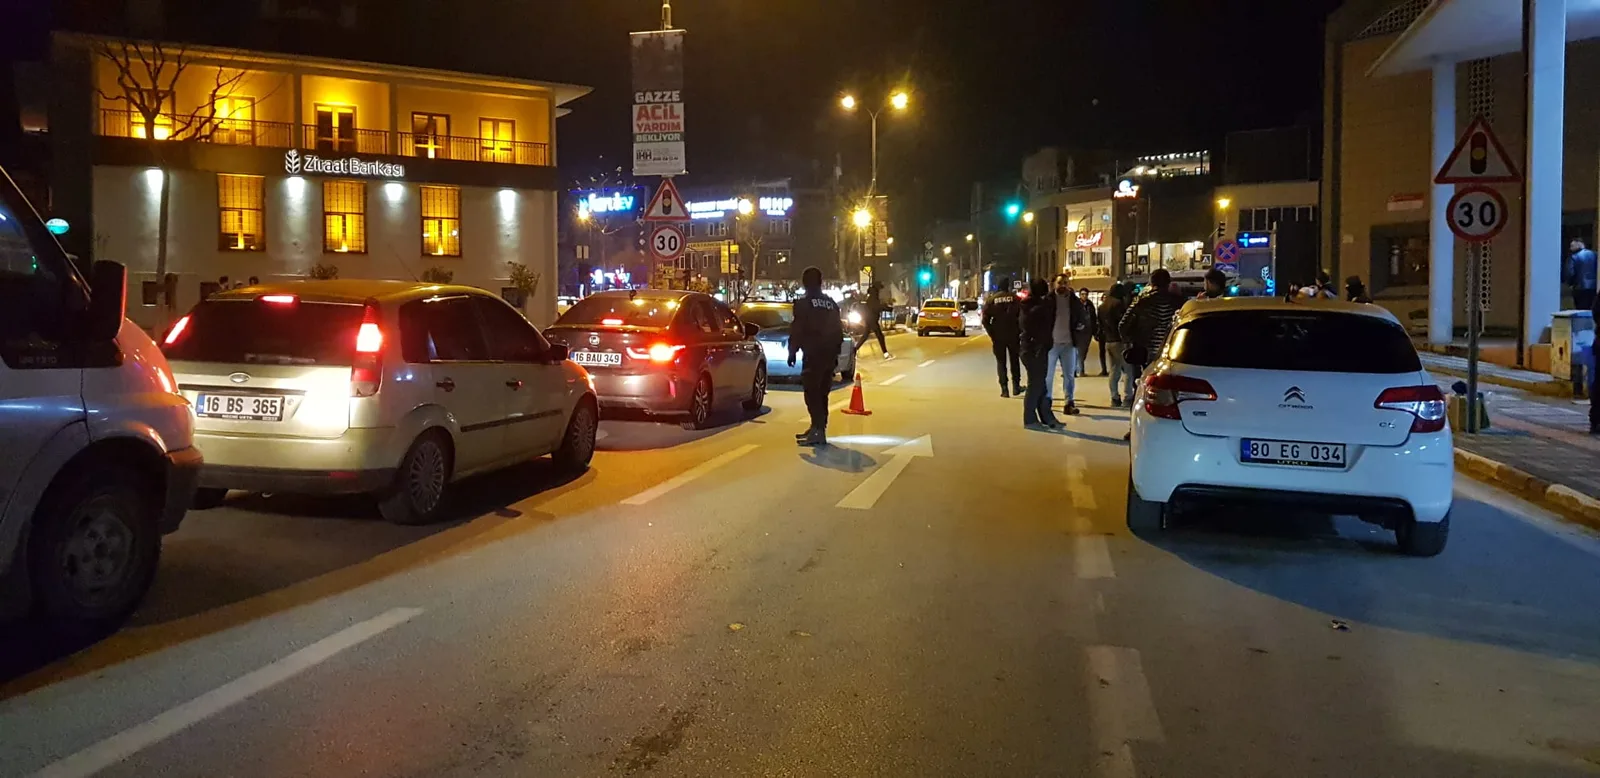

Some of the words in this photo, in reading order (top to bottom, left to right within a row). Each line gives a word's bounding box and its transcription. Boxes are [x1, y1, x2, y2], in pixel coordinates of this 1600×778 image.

[635, 90, 681, 103] GAZZE
[636, 121, 681, 132] YARDIM
[303, 154, 347, 173] Ziraat
[349, 157, 405, 177] Bankası
[1458, 200, 1496, 228] 30
[656, 235, 678, 251] 30
[575, 353, 584, 361] 16
[586, 353, 602, 362] BAU
[603, 354, 620, 363] 349
[206, 397, 220, 412] 16
[227, 398, 243, 412] BS
[252, 399, 277, 414] 365
[1250, 443, 1270, 458] 80
[1280, 444, 1300, 458] EG
[1310, 446, 1340, 460] 034
